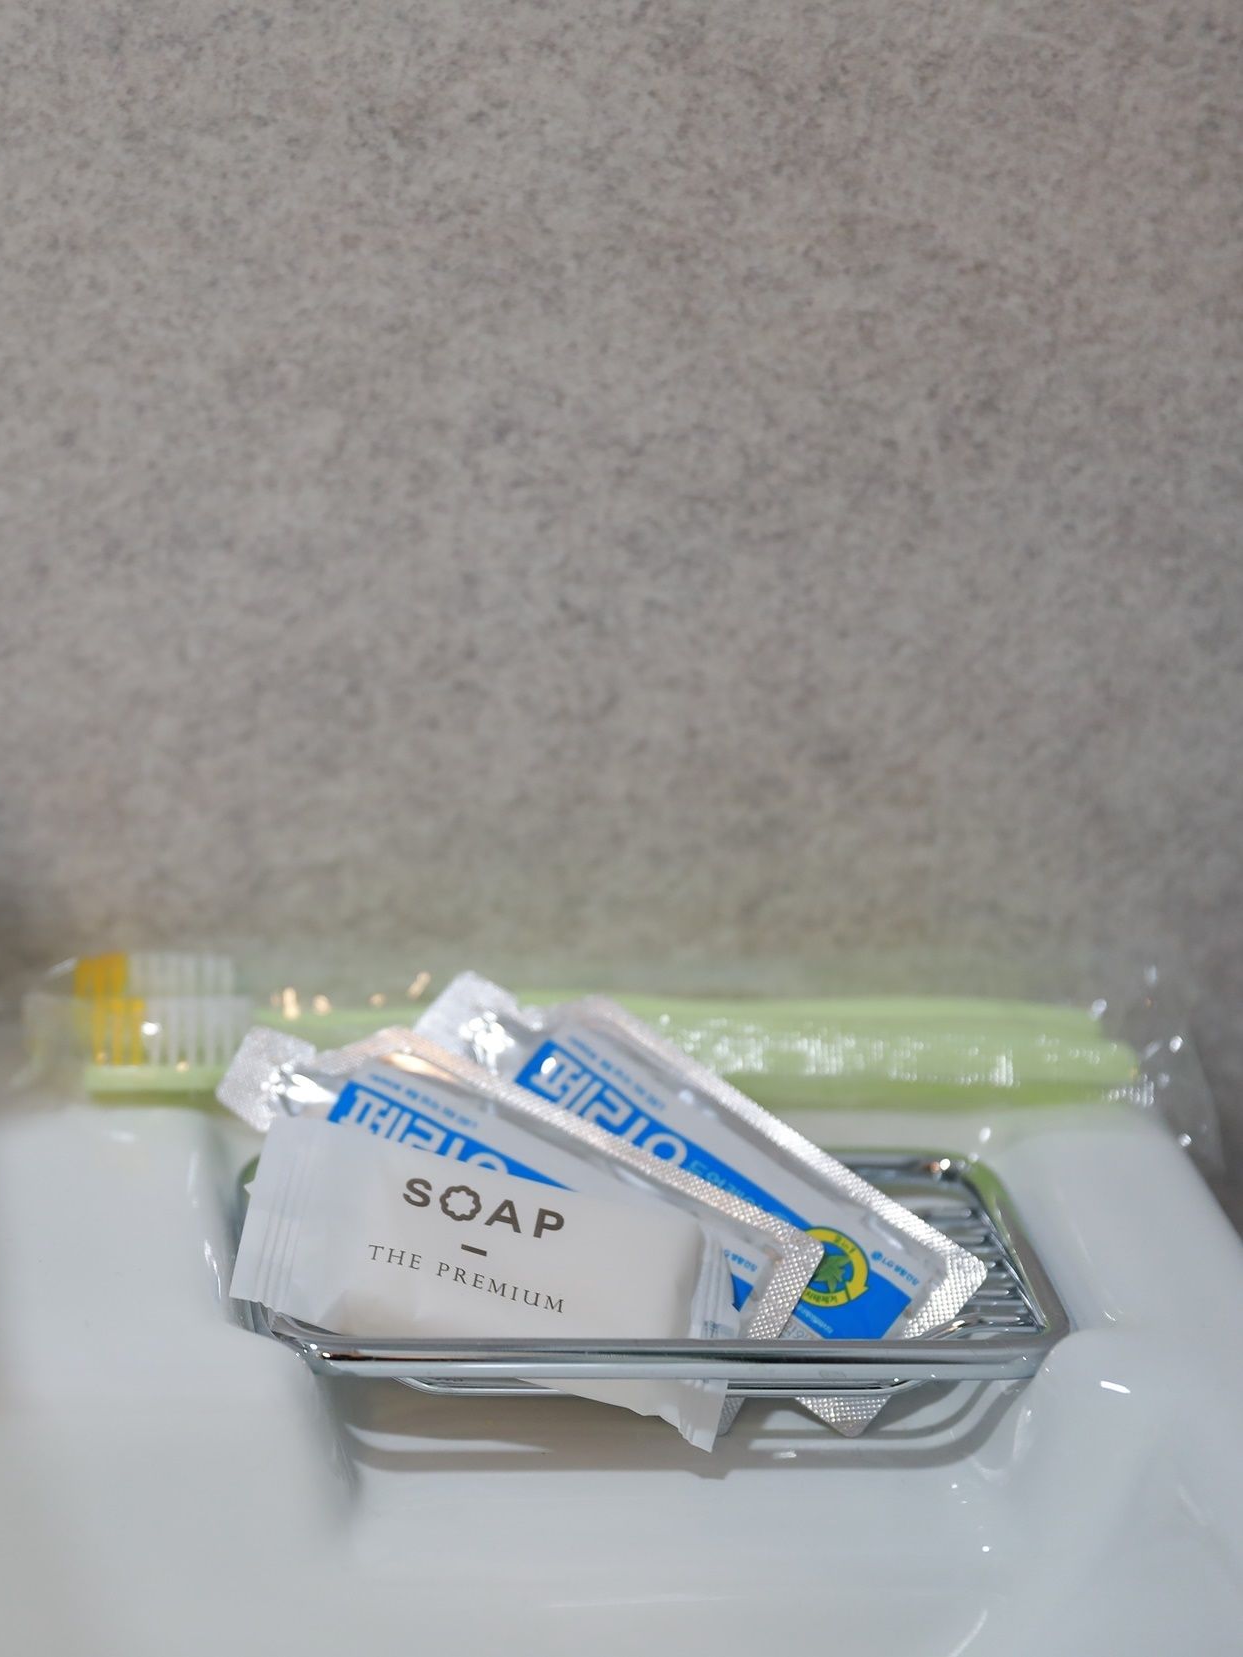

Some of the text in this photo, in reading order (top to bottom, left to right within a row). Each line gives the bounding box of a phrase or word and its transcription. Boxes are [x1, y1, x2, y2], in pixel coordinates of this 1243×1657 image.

[402, 1178, 565, 1239] SOAP
[368, 1244, 565, 1313] THE PREMIUM
